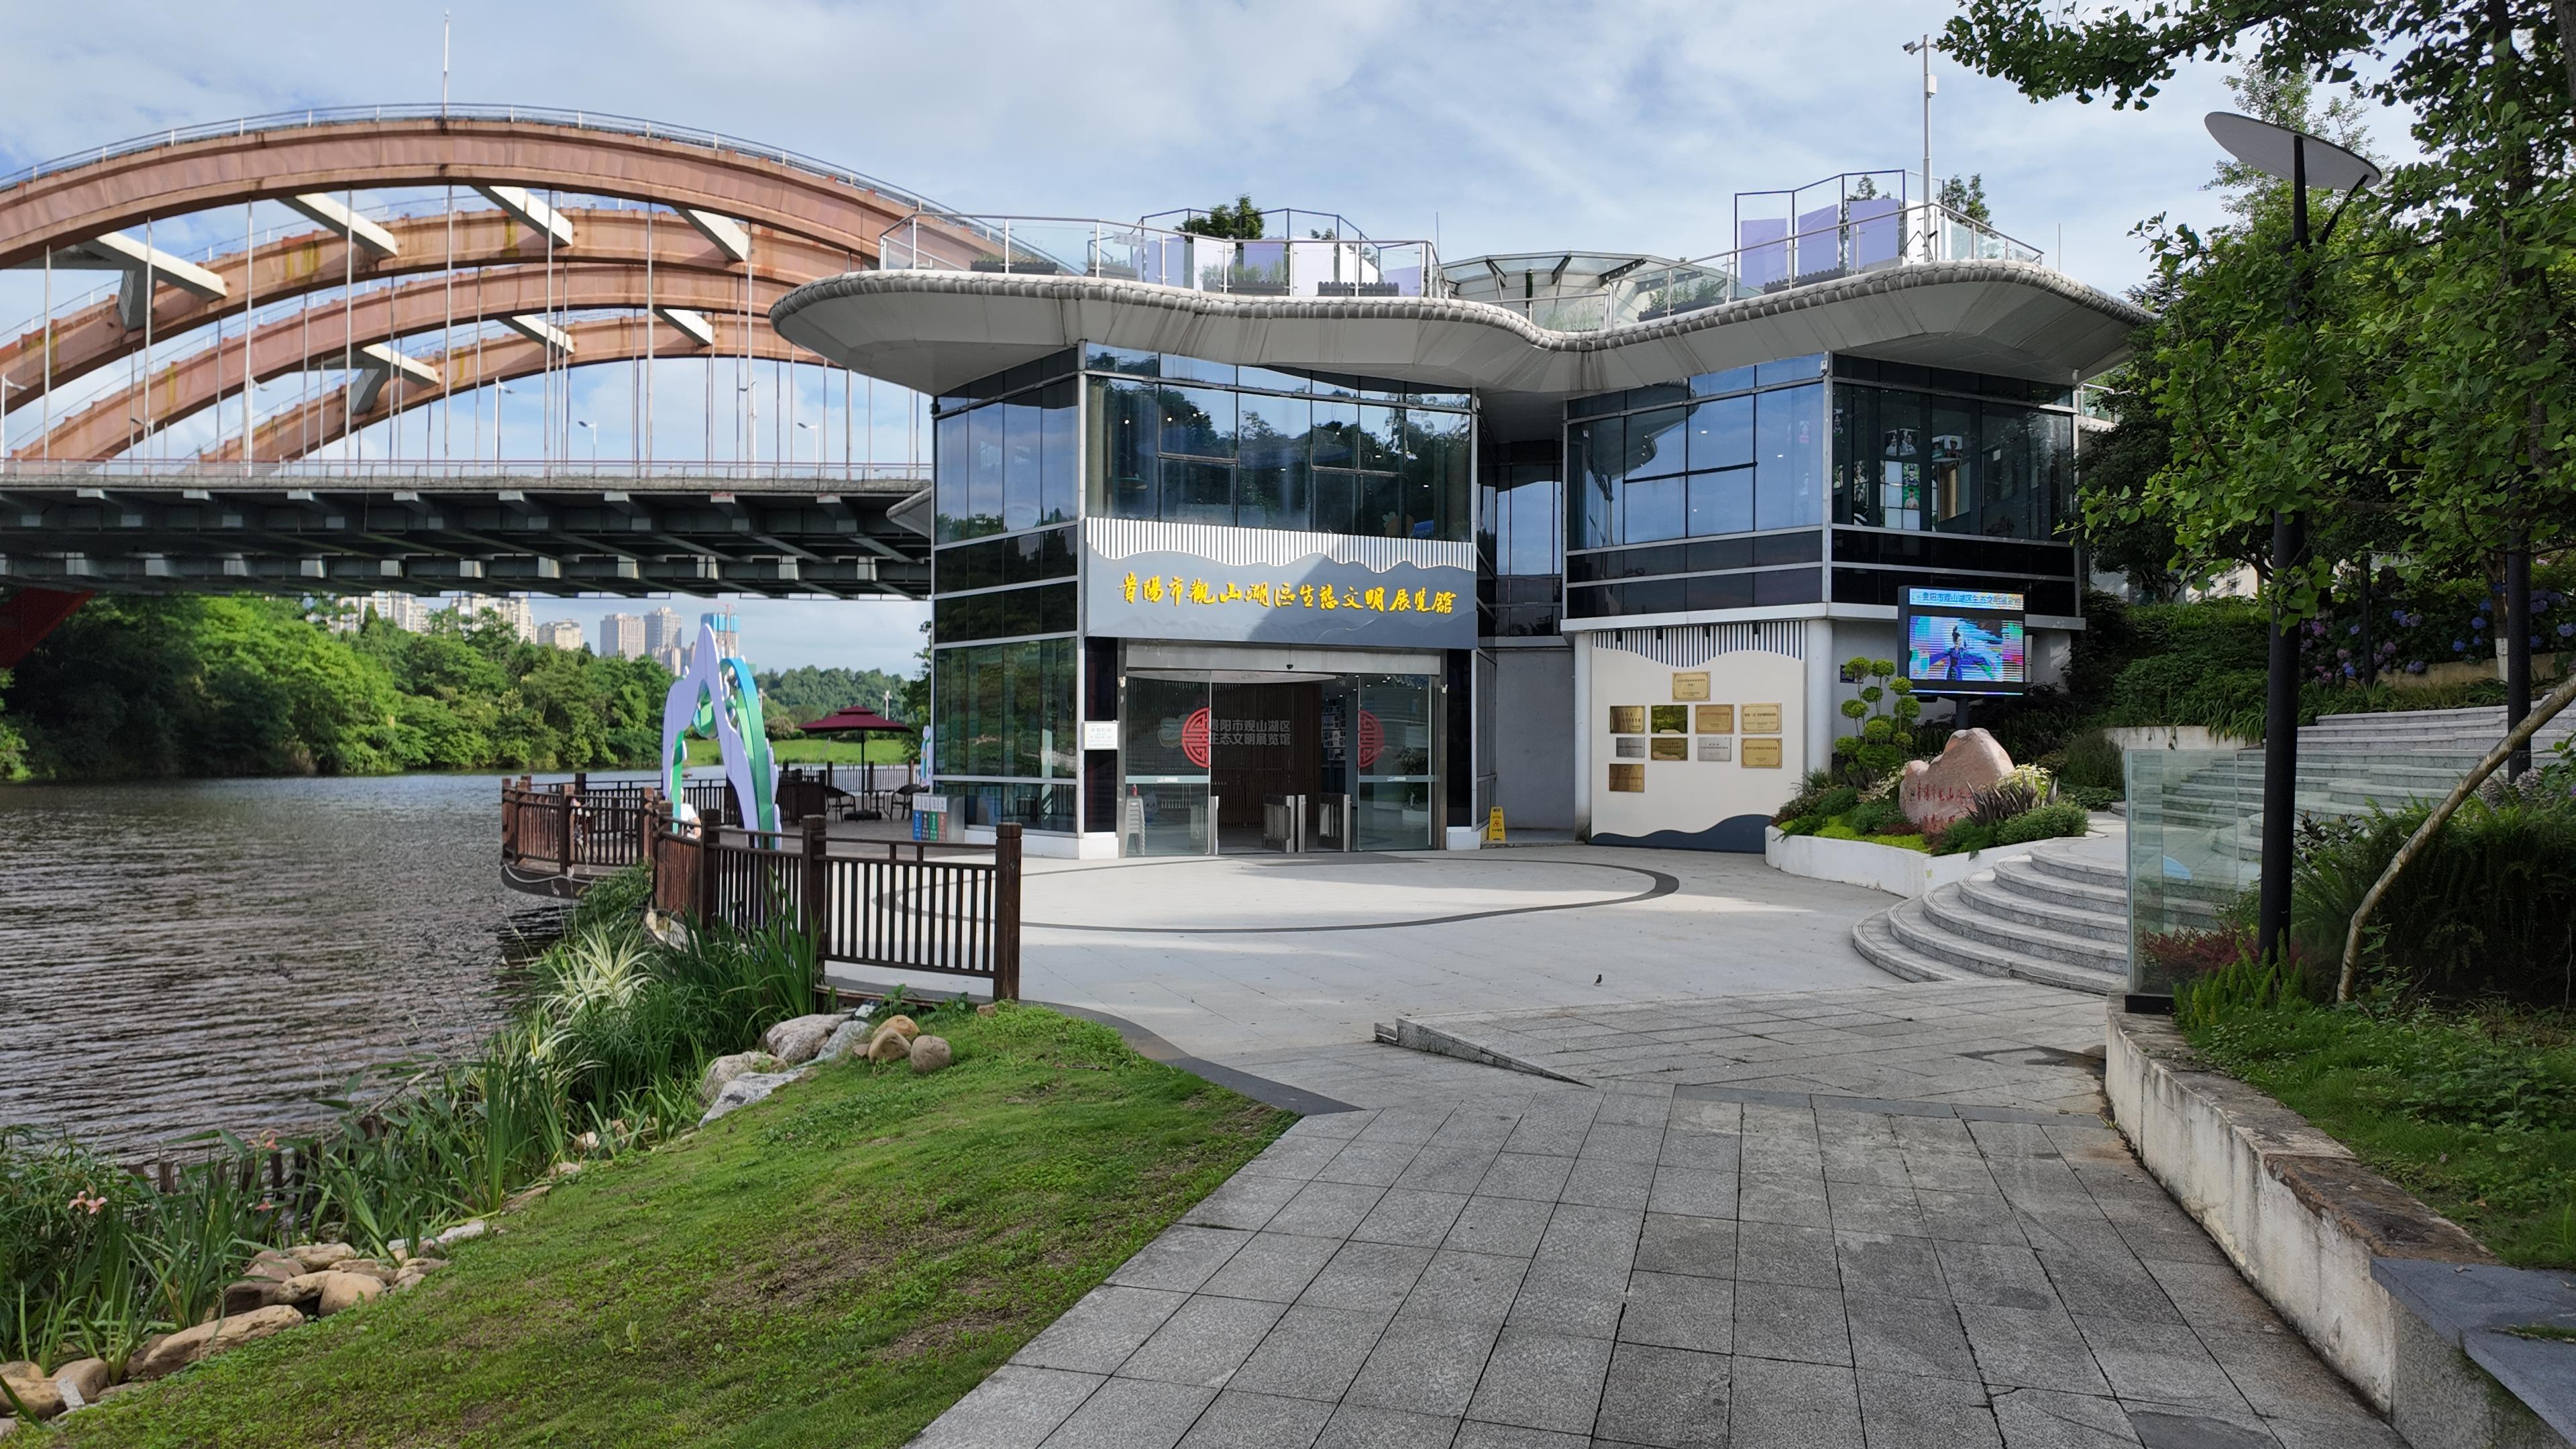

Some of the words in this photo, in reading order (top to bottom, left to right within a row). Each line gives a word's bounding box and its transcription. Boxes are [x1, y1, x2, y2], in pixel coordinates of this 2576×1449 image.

[1212, 718, 1291, 732] 贵阳市观山湖区
[1211, 732, 1291, 745] 生态文明展览馆
